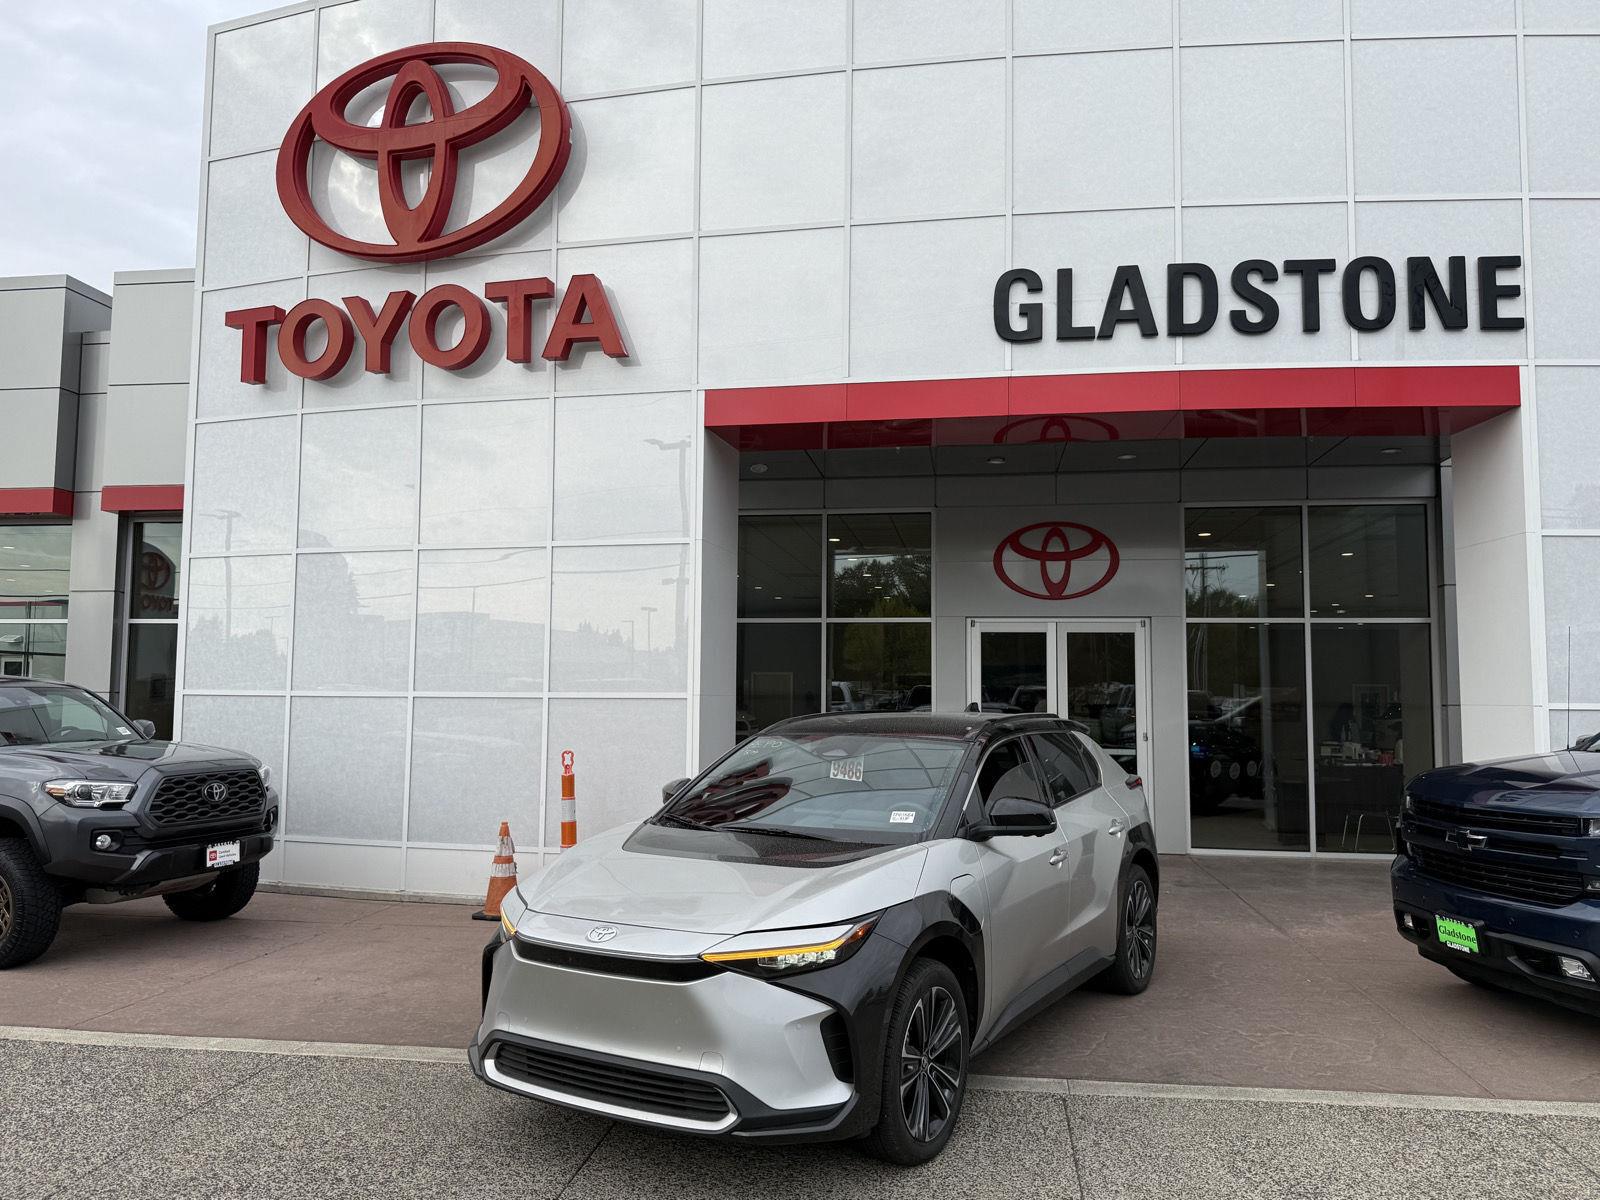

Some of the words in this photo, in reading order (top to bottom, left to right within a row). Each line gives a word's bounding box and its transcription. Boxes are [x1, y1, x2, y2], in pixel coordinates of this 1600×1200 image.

[993, 255, 1526, 343] GLADSTONE
[225, 273, 630, 385] TOYOTA
[832, 760, 862, 780] 9486
[1439, 925, 1477, 943] Gladstone
